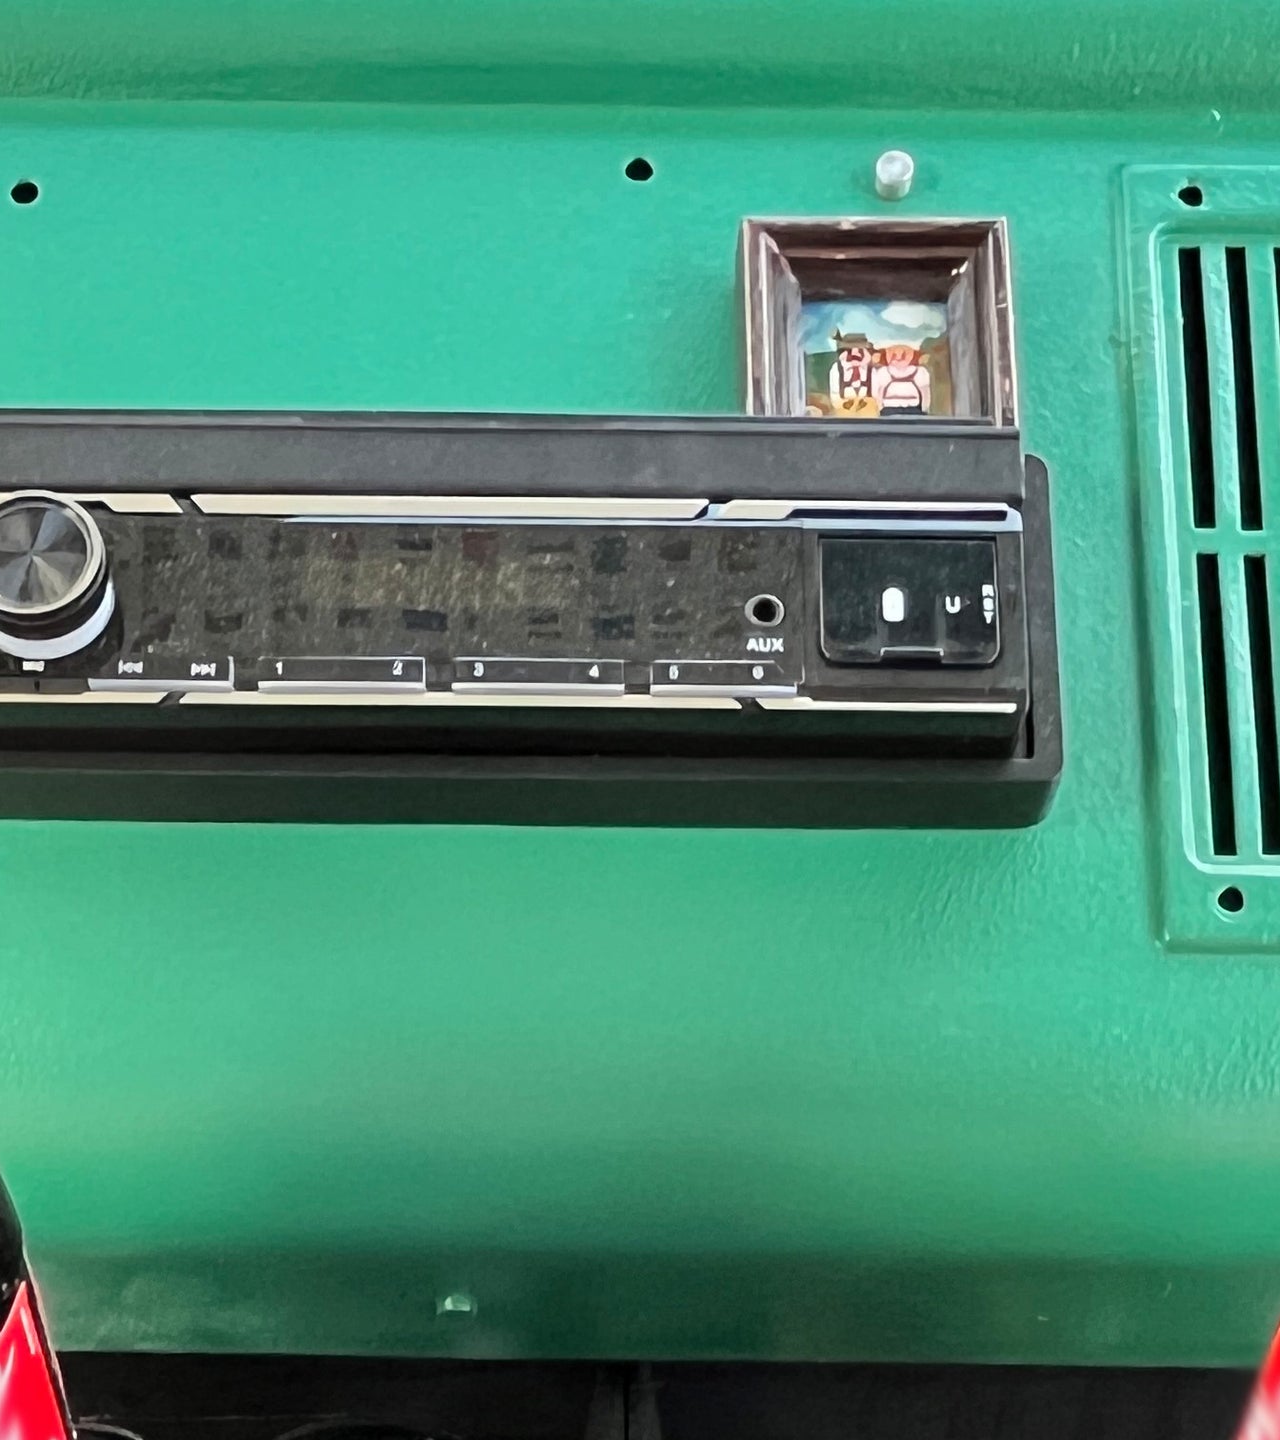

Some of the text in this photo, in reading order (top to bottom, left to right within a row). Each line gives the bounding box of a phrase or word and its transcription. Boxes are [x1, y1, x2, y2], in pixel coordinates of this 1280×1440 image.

[745, 637, 785, 653] AUX
[275, 660, 283, 676] 1
[472, 661, 485, 678] 3
[588, 663, 600, 679] 4
